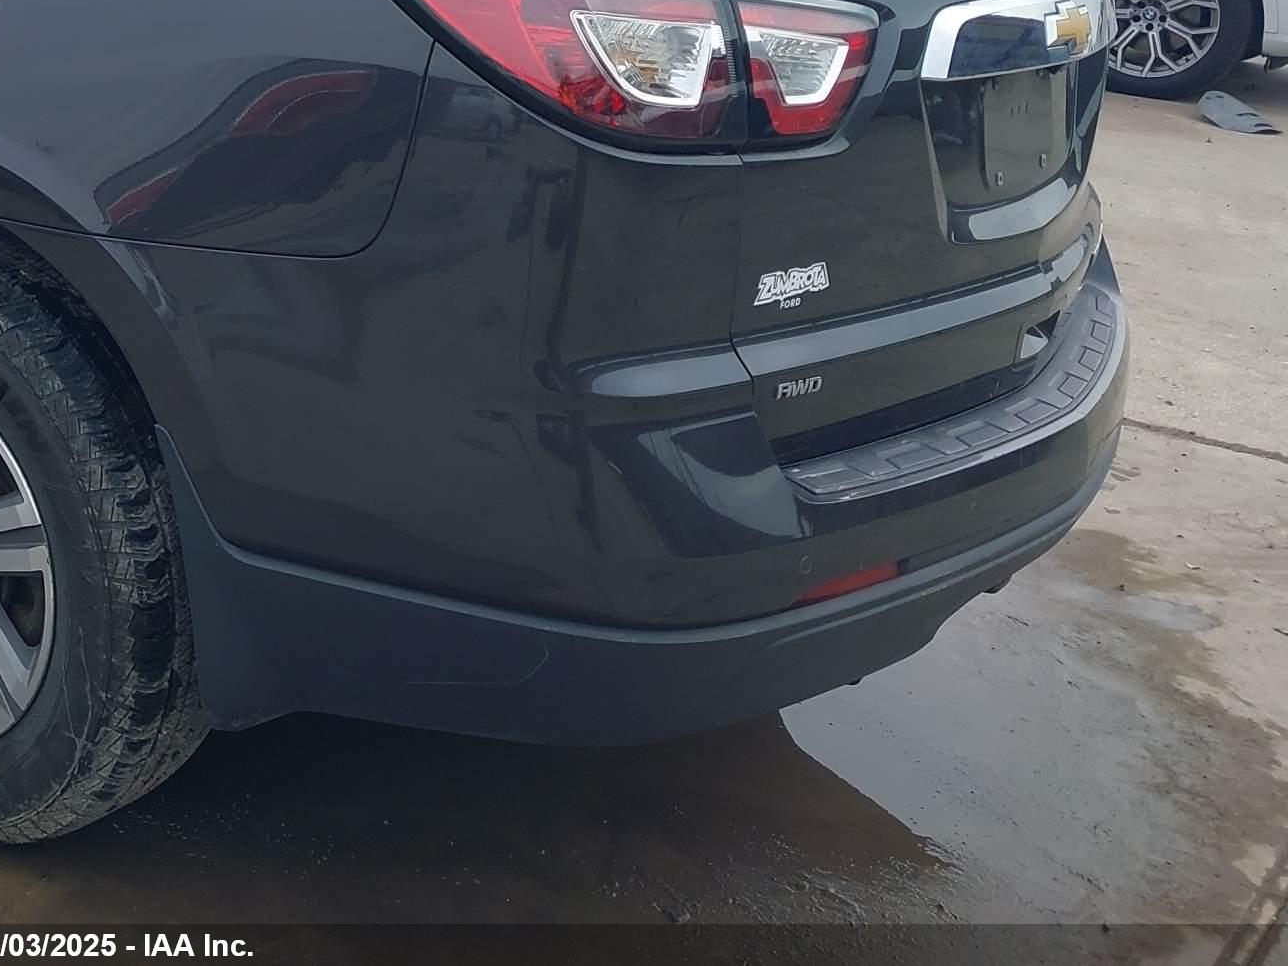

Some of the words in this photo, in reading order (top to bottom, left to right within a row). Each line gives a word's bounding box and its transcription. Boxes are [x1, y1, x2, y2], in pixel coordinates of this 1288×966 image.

[755, 262, 829, 305] ZUMBROTA
[779, 297, 802, 310] FORD
[776, 376, 823, 400] AWD
